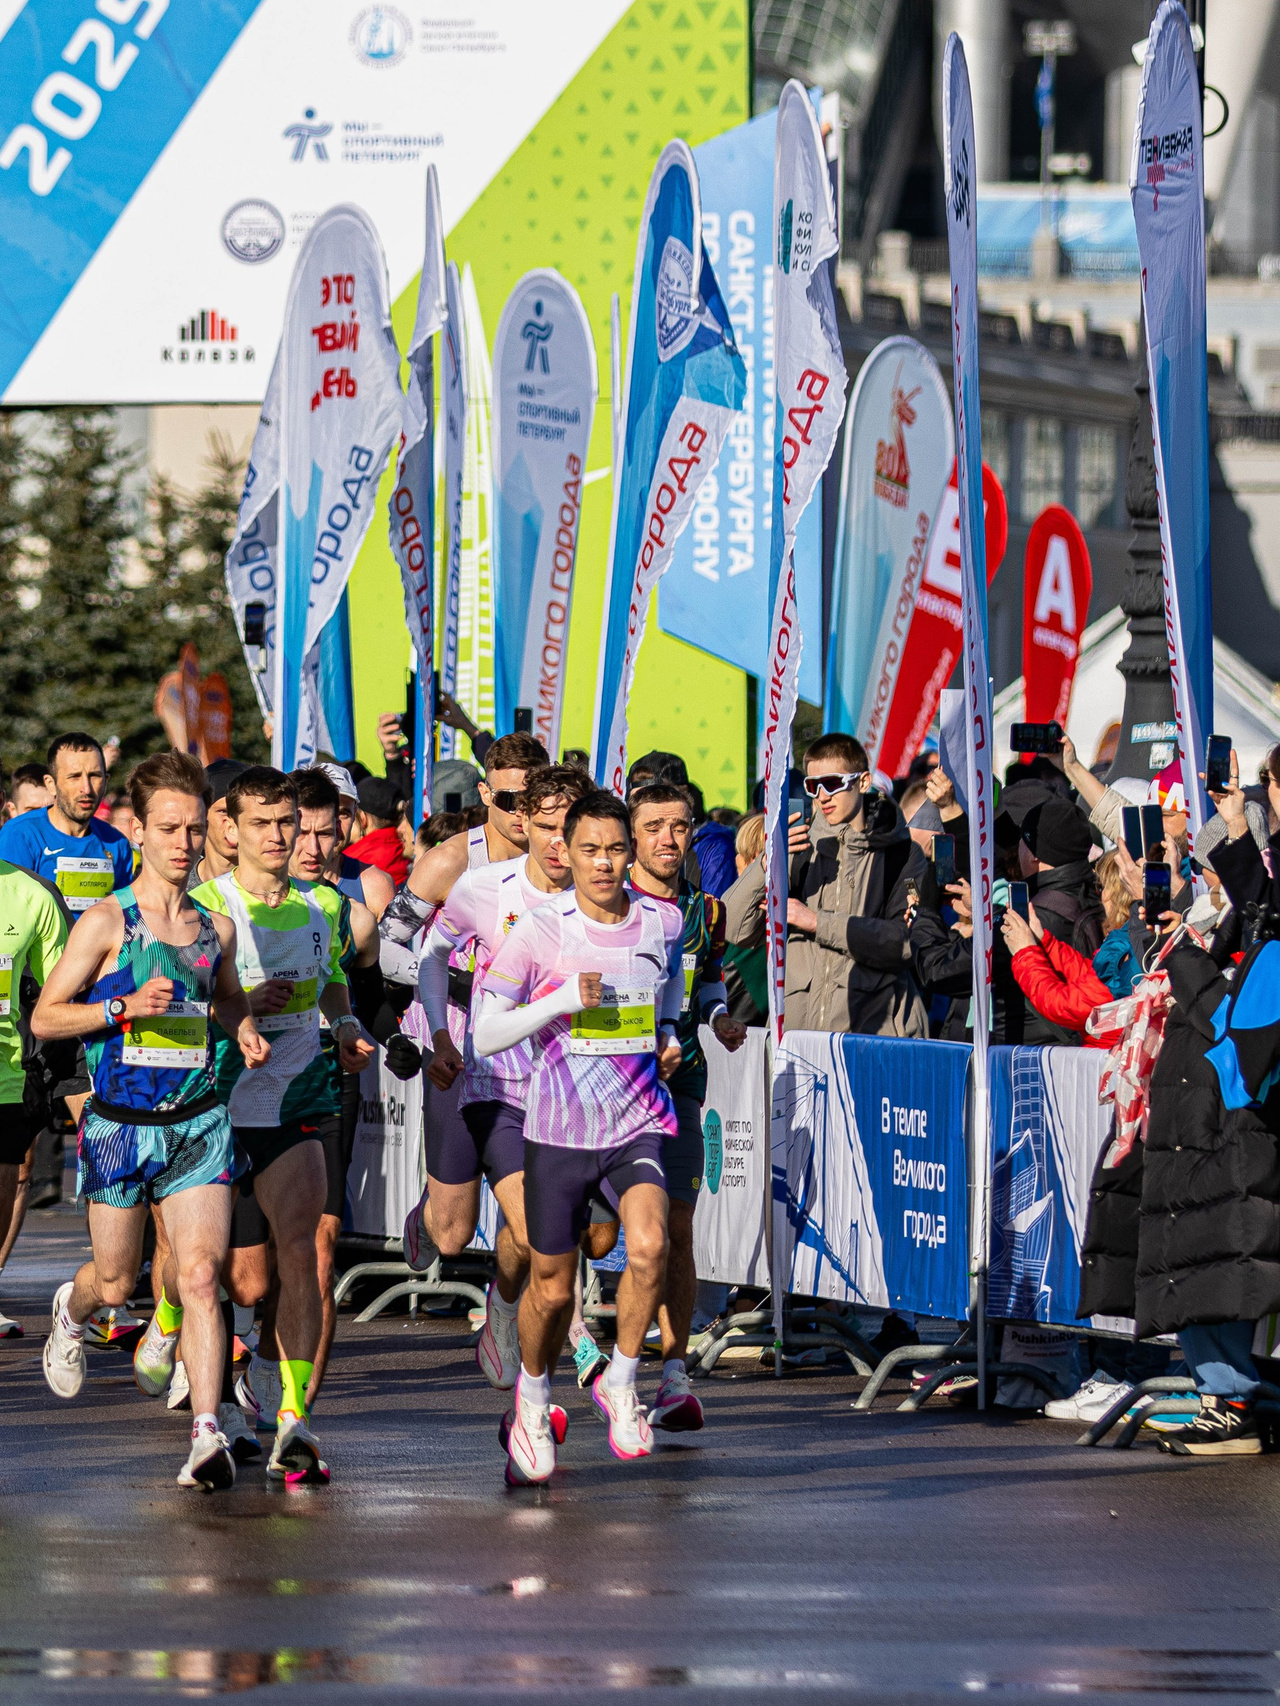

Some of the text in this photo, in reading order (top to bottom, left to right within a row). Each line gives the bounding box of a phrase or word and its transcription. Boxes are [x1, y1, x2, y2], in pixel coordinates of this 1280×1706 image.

[322, 273, 355, 307] ЭТО
[517, 400, 581, 425] СПОРТИВНЫЙ
[517, 420, 567, 441] ПЕТЕРБУРГ
[636, 402, 706, 595] города
[309, 444, 375, 608] орода
[549, 451, 581, 592] города
[873, 511, 930, 638] города
[157, 1028, 196, 1036] ПАВЕЛЬЕВ
[603, 1017, 644, 1026] ЧЕРТЫКОВ
[881, 1097, 928, 1139] В темпе
[893, 1149, 946, 1193] Великого
[903, 1210, 946, 1250] города
[1011, 1331, 1076, 1344] PushkinRu
